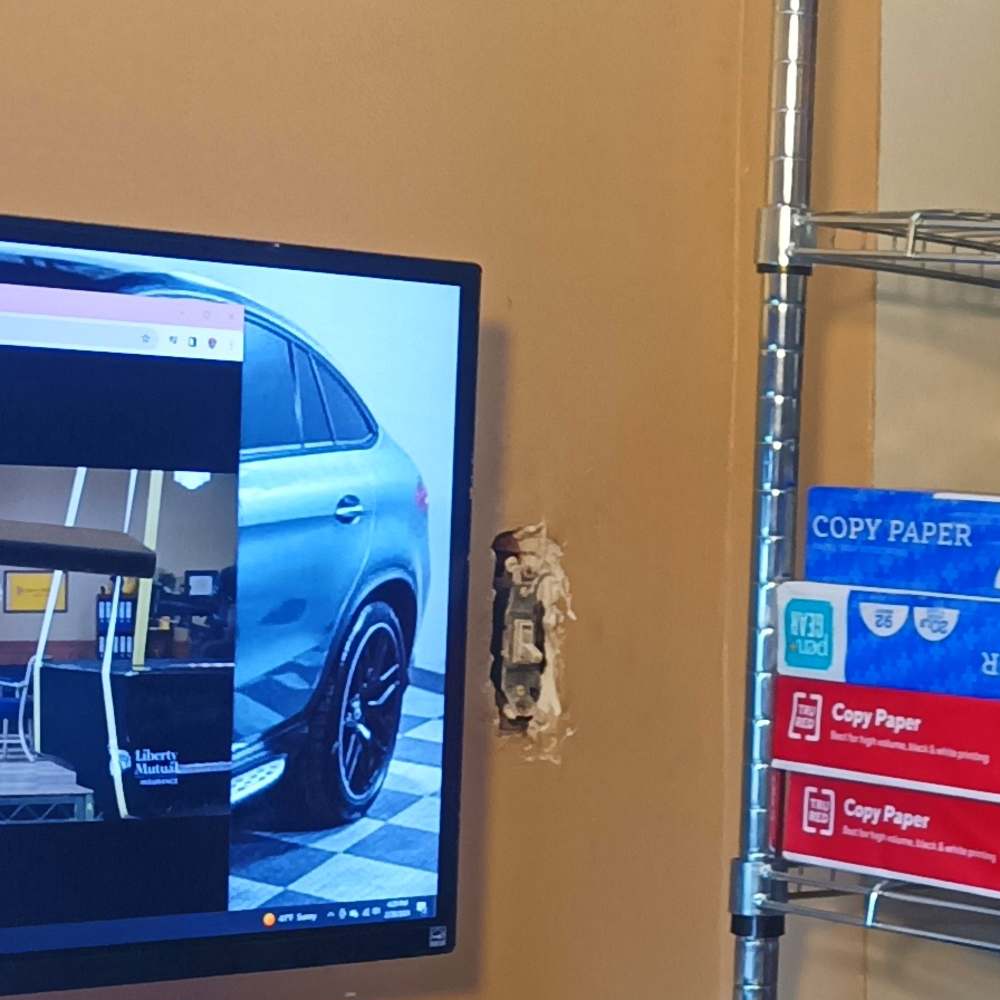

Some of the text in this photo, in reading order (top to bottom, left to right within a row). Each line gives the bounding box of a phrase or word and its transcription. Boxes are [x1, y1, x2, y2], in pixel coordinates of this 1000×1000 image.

[812, 515, 973, 547] COPY PAPER
[790, 610, 825, 639] GEAR
[831, 702, 922, 734] Copy Paper
[134, 748, 178, 762] Liberty
[843, 797, 930, 831] Copy Paper
